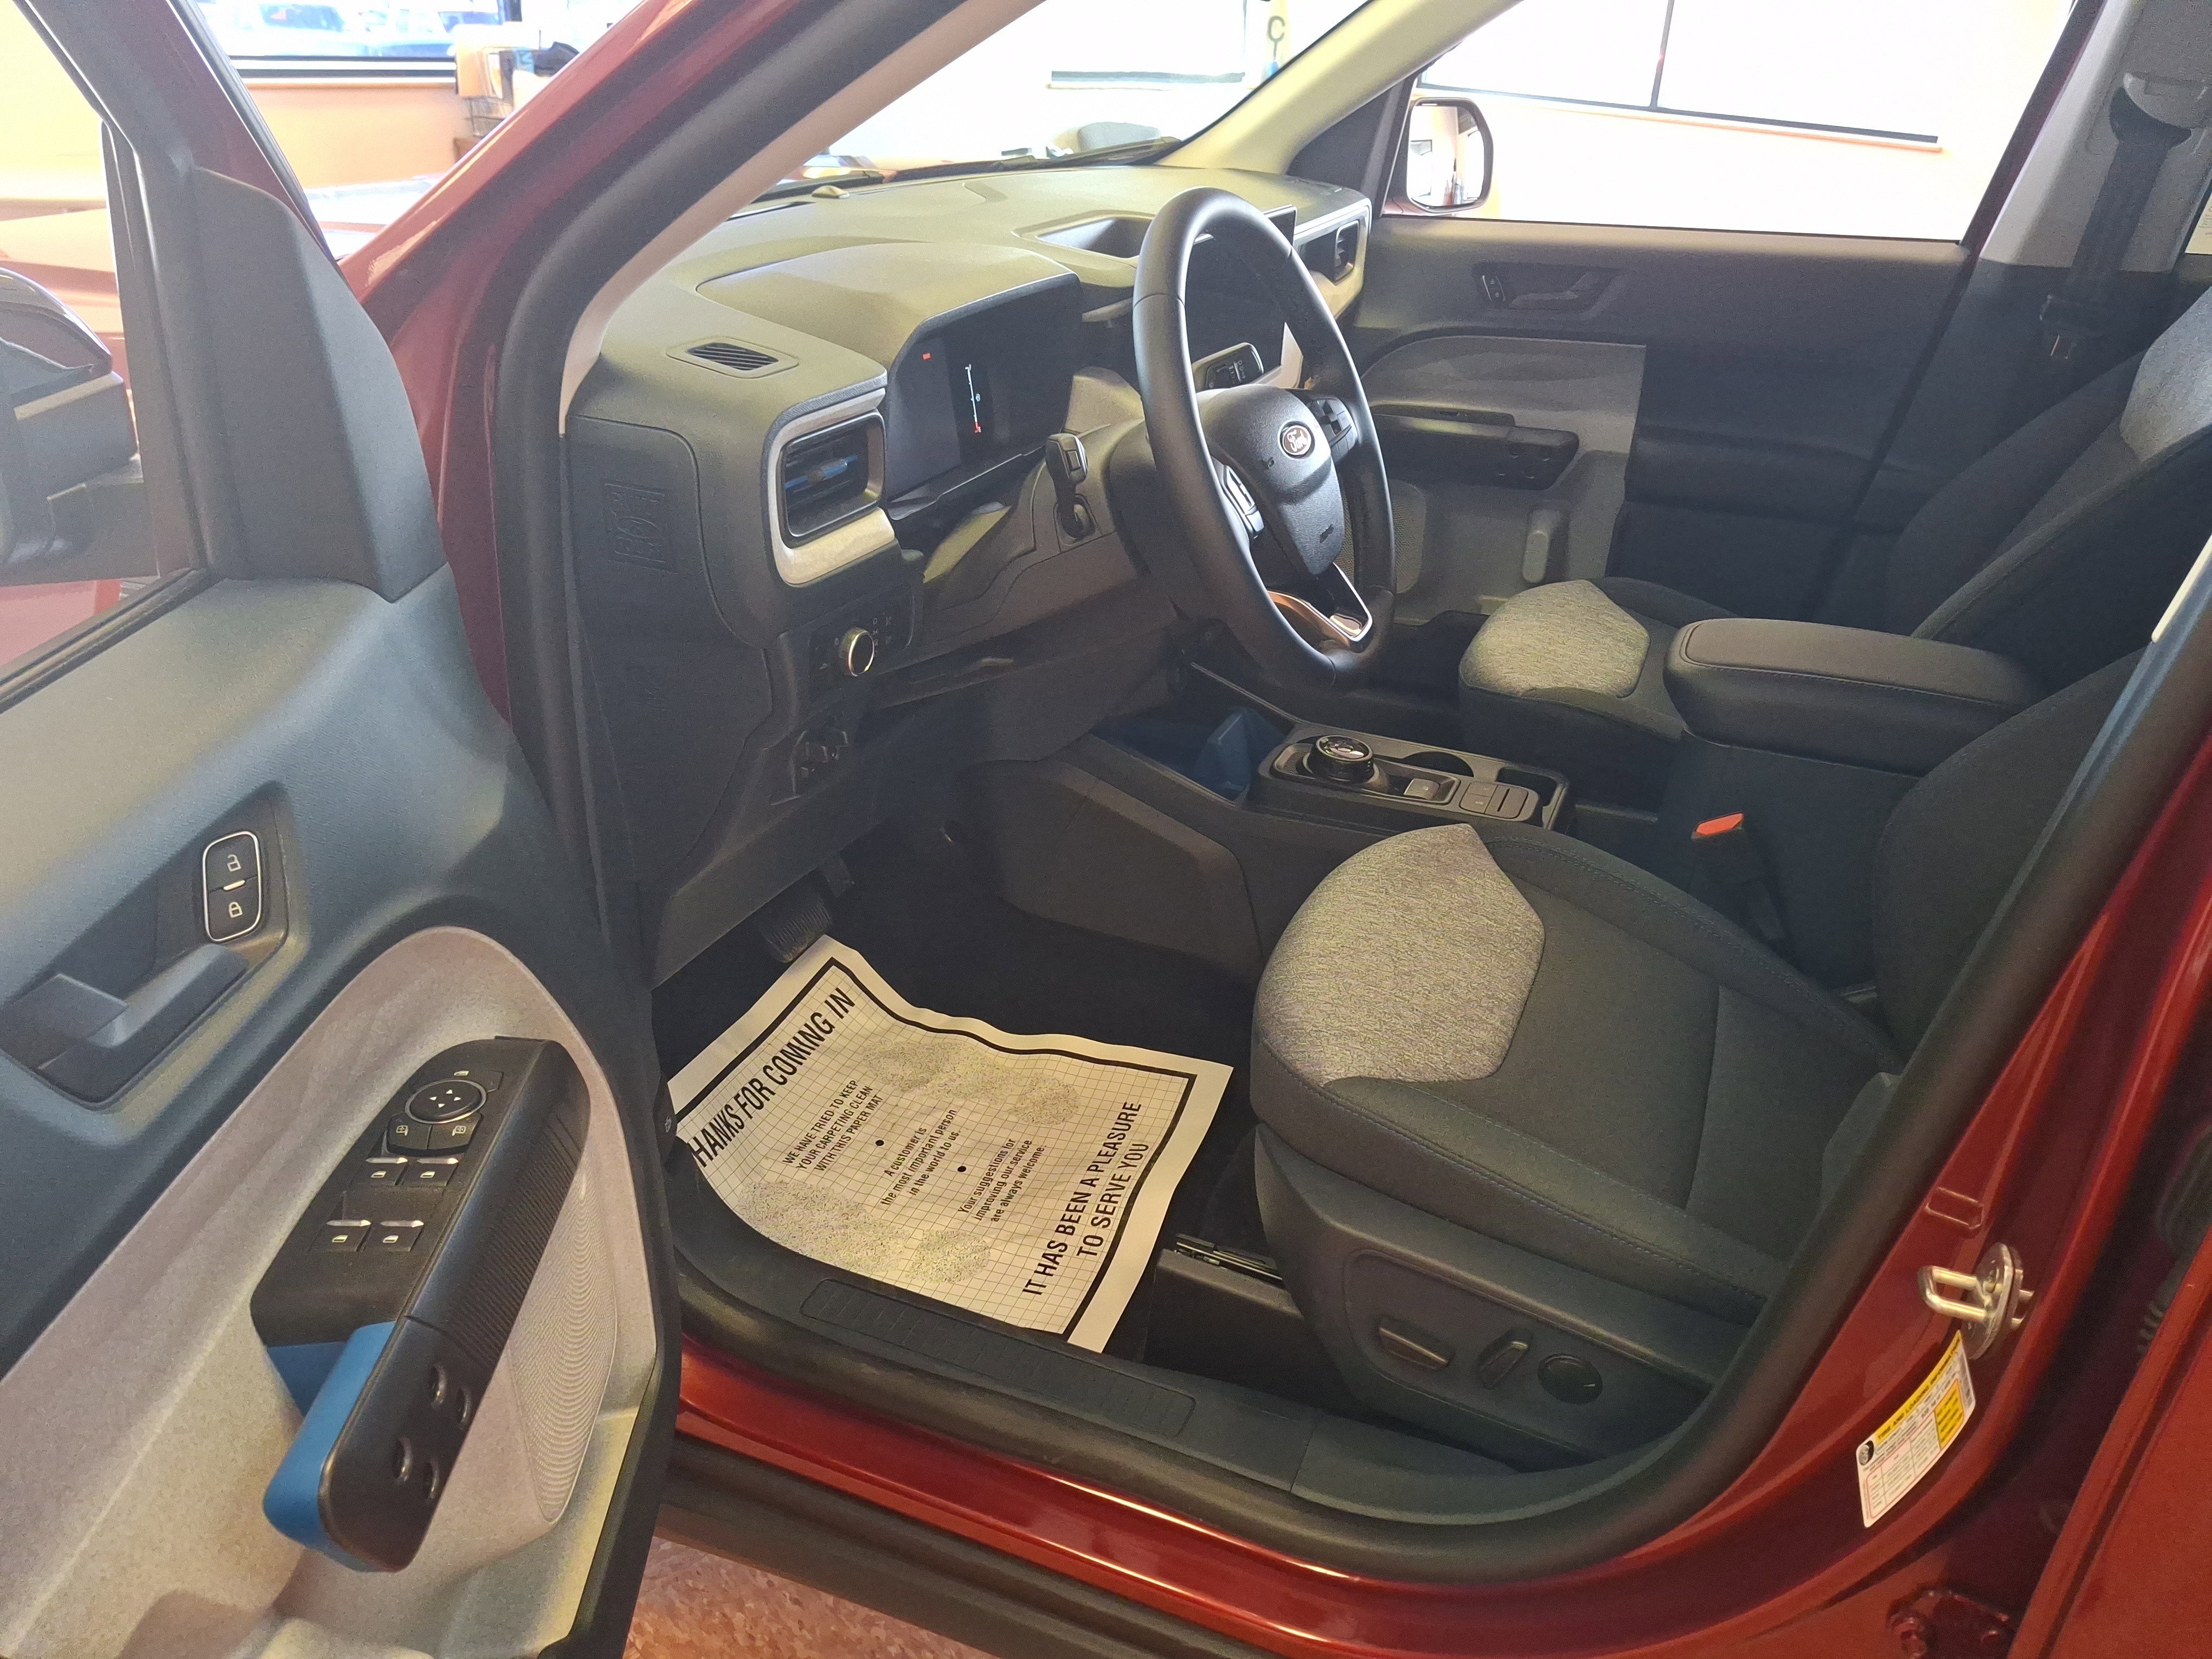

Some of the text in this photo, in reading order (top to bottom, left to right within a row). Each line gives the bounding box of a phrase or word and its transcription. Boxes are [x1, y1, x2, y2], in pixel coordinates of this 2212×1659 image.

[687, 987, 856, 1168] HANKS FOR COMING IN
[782, 1080, 858, 1164] WE HAVE TRIED TO KEEP
[795, 1086, 873, 1169] YOUR CARPETING CLEAN
[814, 1095, 883, 1171] WITH THIS PAPER MAT
[880, 1109, 957, 1205] the most important person
[891, 1136, 921, 1170] customer
[907, 1131, 961, 1195] in the world to us.
[957, 1139, 1016, 1213] Your suggestions for
[972, 1140, 1032, 1220] improving our service
[991, 1209, 1005, 1221] are
[1000, 1180, 1023, 1207] always
[1022, 1102, 1142, 1295] IT HAS BEEN A PLEASURE
[1076, 1143, 1149, 1256] TO SERVE YOU
